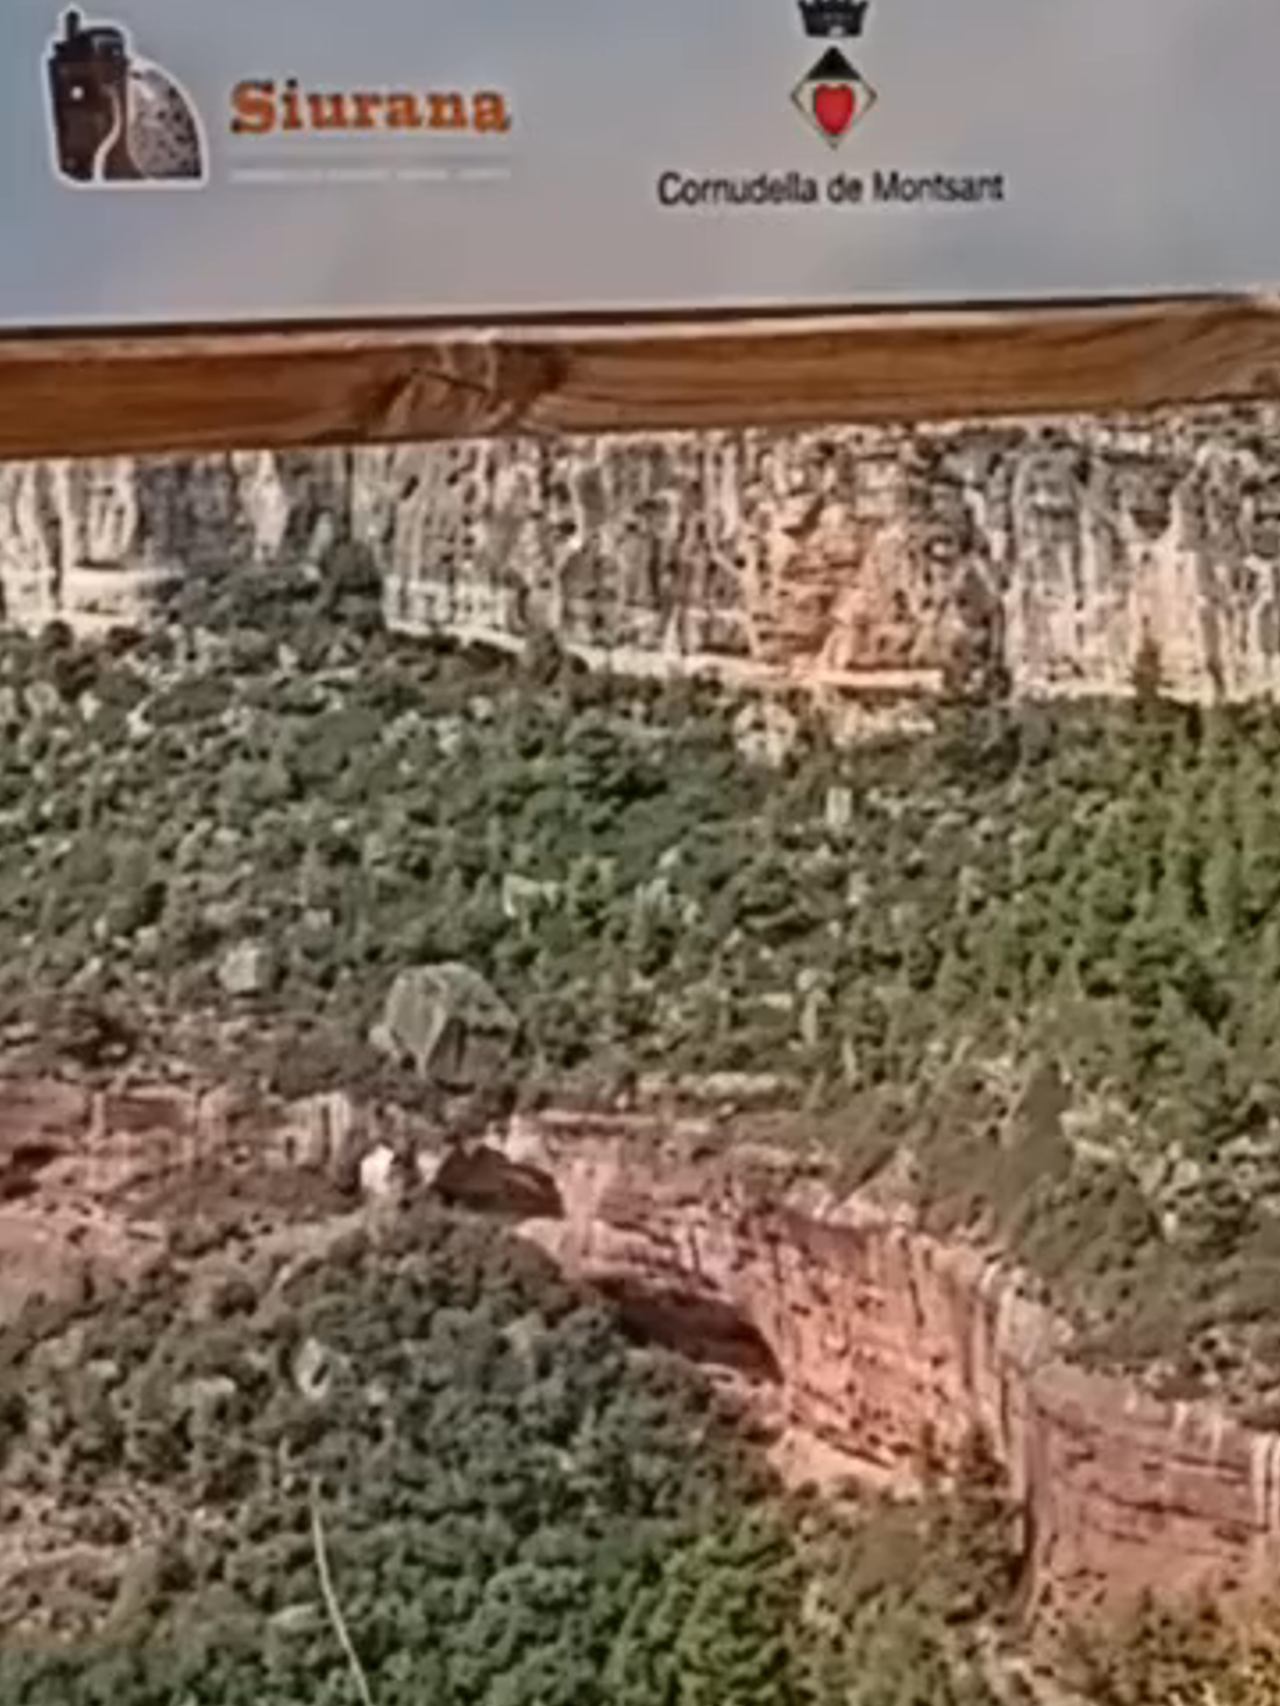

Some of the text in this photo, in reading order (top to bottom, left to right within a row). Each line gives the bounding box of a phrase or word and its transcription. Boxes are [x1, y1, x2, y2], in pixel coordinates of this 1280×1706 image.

[229, 77, 512, 135] Siurana
[657, 169, 1005, 207] Cornudella de Montsant
